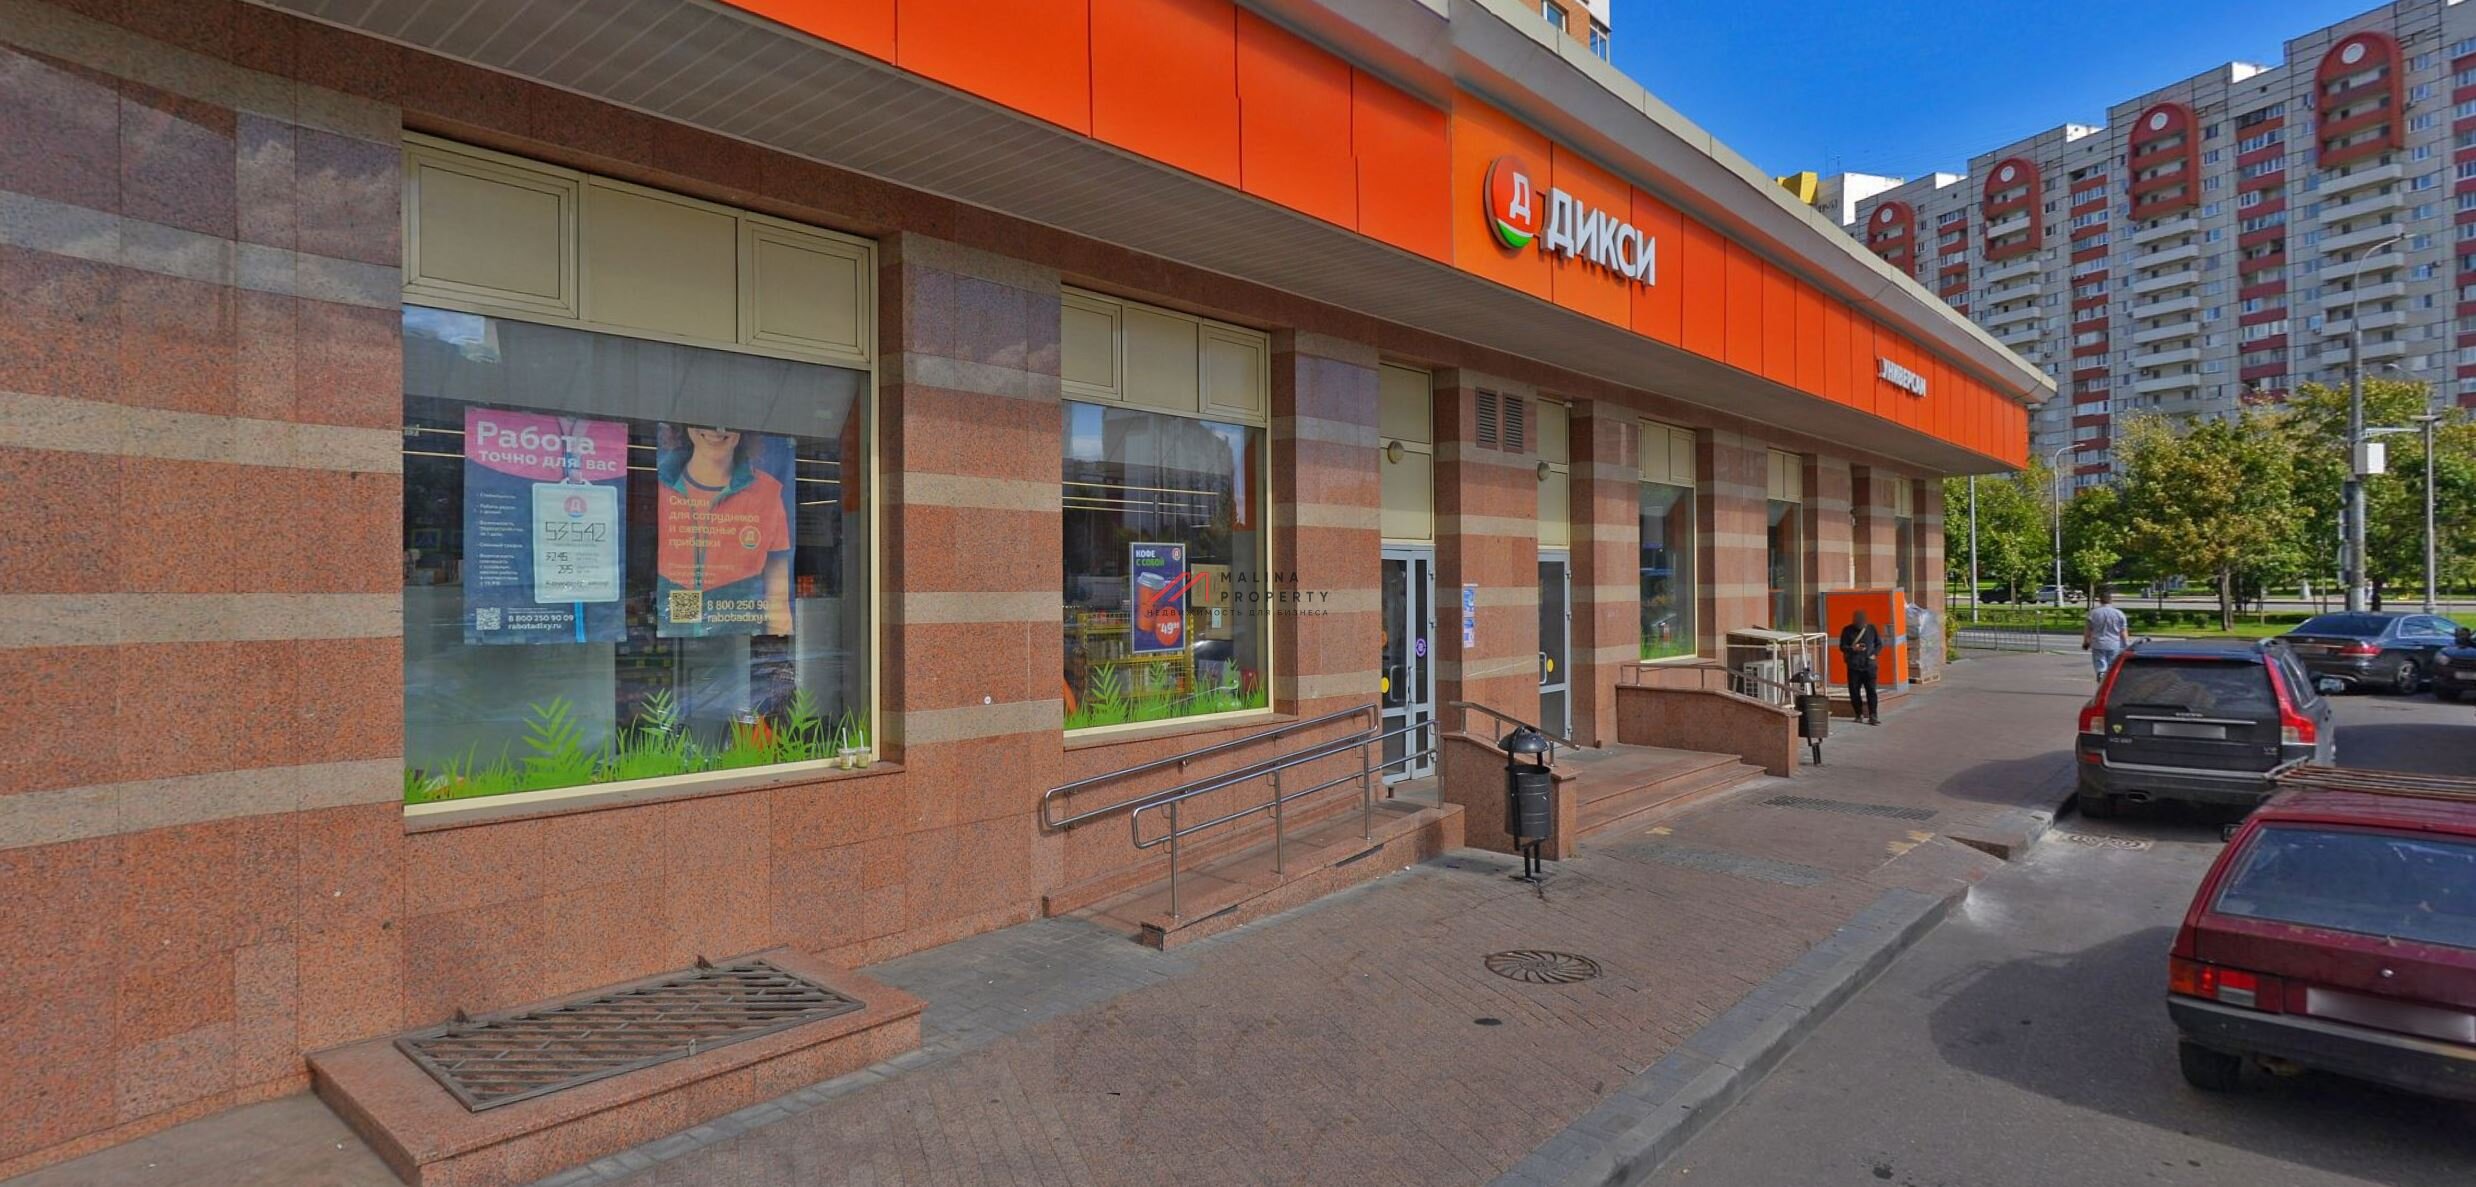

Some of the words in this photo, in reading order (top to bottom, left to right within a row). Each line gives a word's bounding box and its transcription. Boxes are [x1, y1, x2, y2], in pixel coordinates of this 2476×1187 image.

[1509, 171, 1531, 225] Д
[1545, 187, 1656, 286] ДИКСИ
[476, 421, 596, 455] Работа
[479, 450, 538, 466] точно
[542, 456, 580, 469] для
[586, 459, 617, 471] вас
[668, 511, 690, 521] для
[692, 512, 761, 524] сотрудников
[669, 525, 676, 533] и
[678, 526, 737, 536] ежегодные
[668, 536, 721, 549] прибавки
[1135, 549, 1156, 558] КОФЕ
[716, 600, 735, 610] 800
[736, 600, 755, 610] 250
[508, 615, 514, 623] 8
[515, 615, 533, 623] 800
[551, 614, 562, 622] 90
[563, 614, 574, 622] 09
[707, 612, 771, 624] rabotadixy.r
[508, 623, 562, 631] rabotadixy.ru
